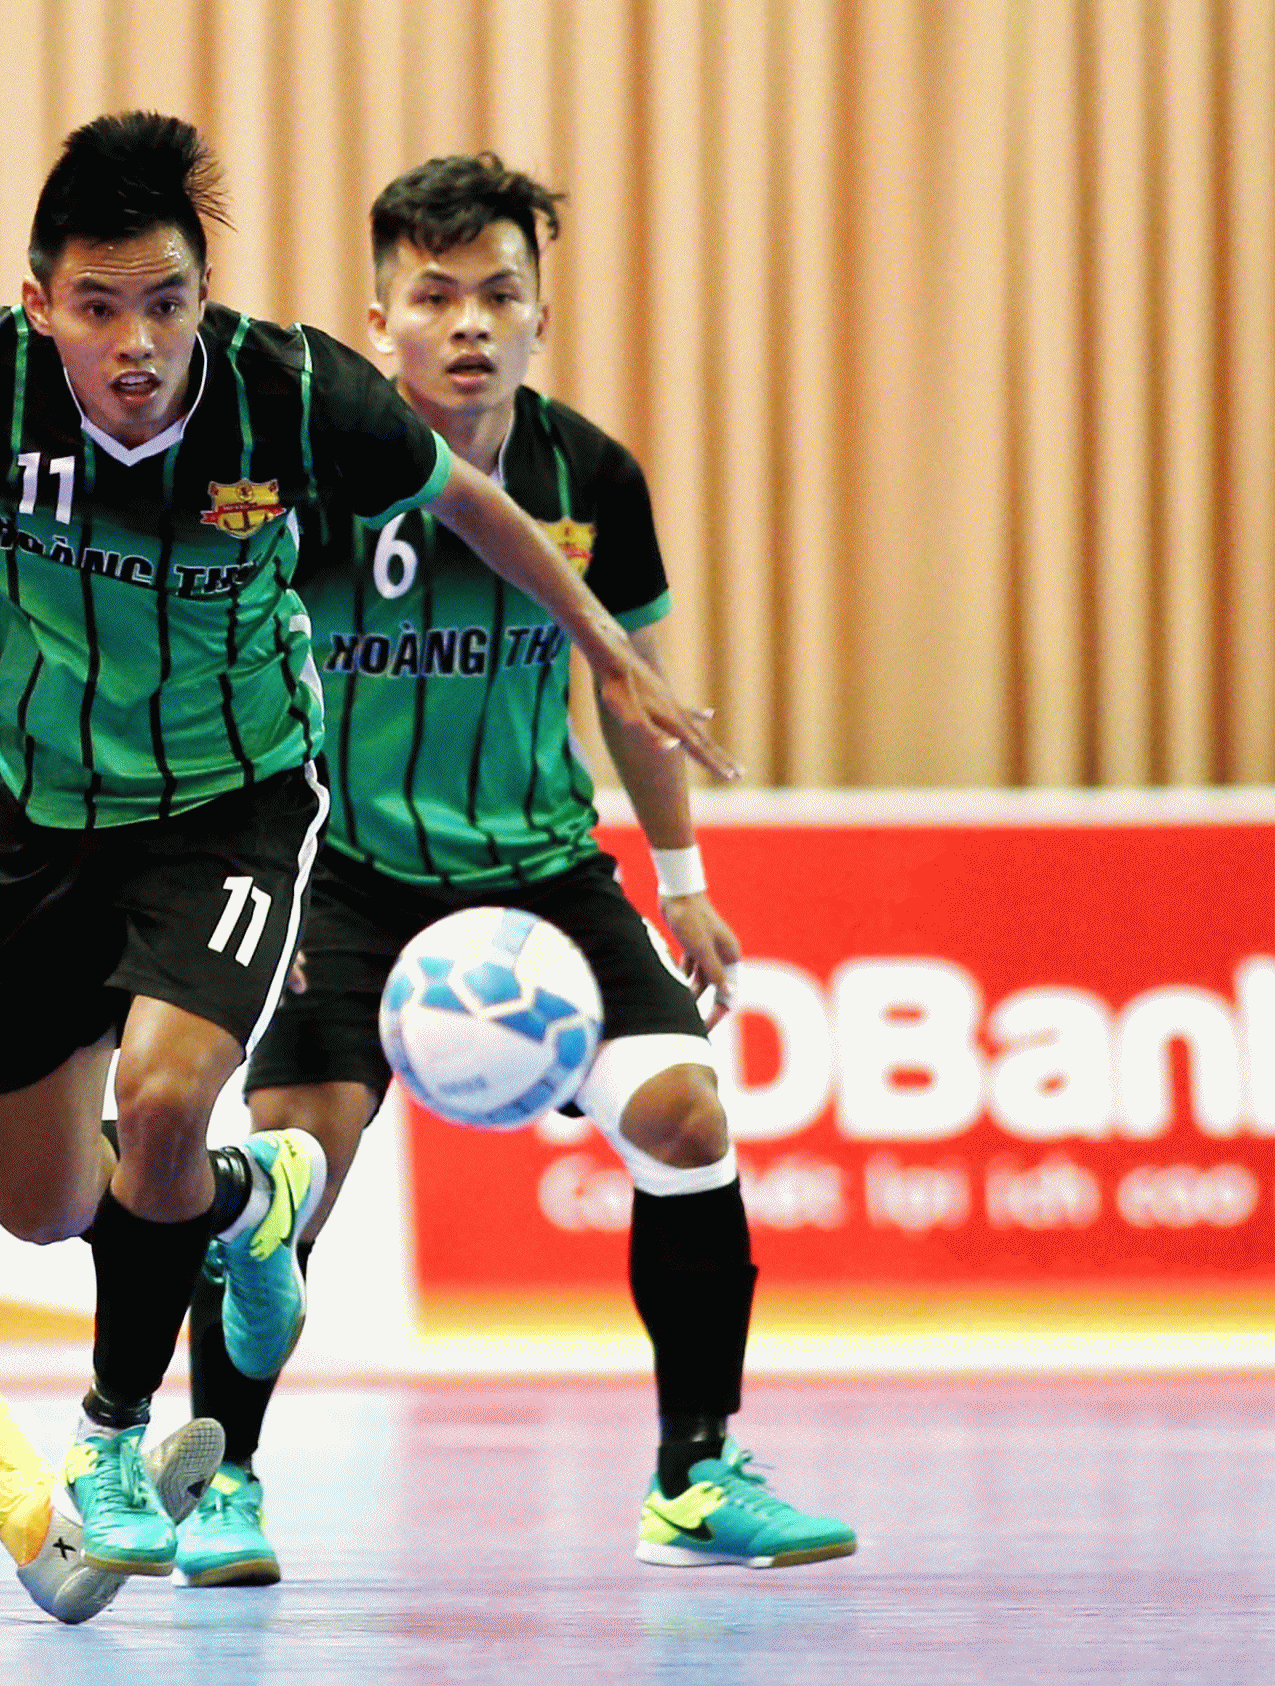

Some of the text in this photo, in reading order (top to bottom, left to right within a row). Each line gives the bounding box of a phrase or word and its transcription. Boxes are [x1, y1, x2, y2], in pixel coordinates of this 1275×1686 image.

[17, 452, 75, 525] 11
[374, 511, 418, 599] 6
[207, 876, 272, 967] 11
[536, 953, 1275, 1143] DBan
